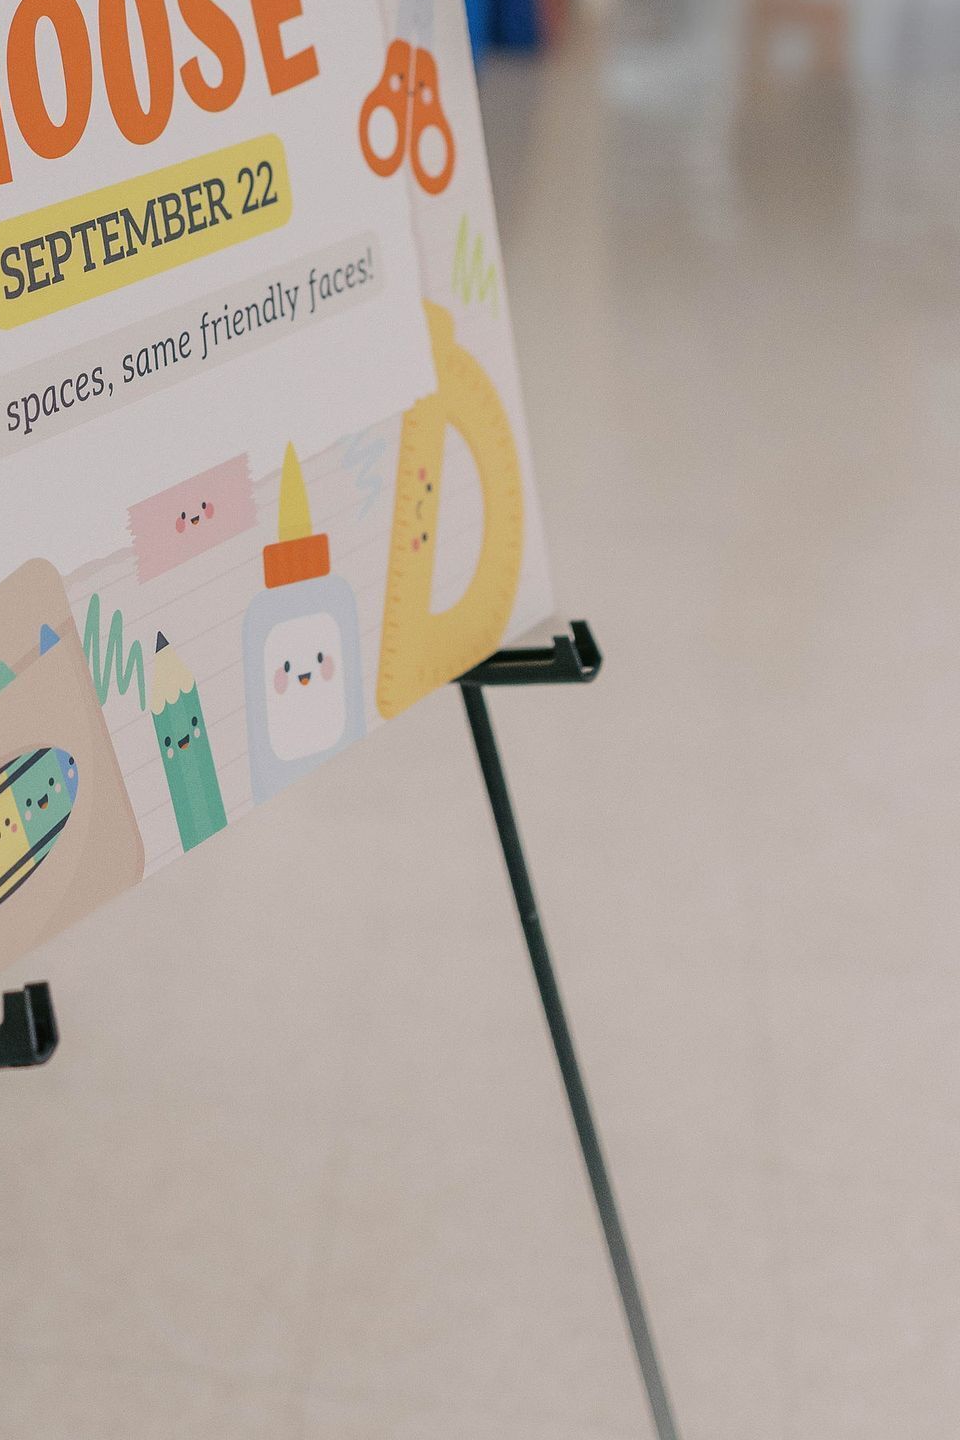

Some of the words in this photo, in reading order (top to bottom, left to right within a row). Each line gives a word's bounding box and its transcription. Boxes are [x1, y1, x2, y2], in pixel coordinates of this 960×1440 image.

[1, 178, 232, 300] SEPTEMBER
[238, 161, 279, 214] 22
[7, 367, 114, 435] spaces,
[123, 332, 192, 383] same
[200, 283, 299, 360] friendly
[309, 248, 374, 314] faces!
